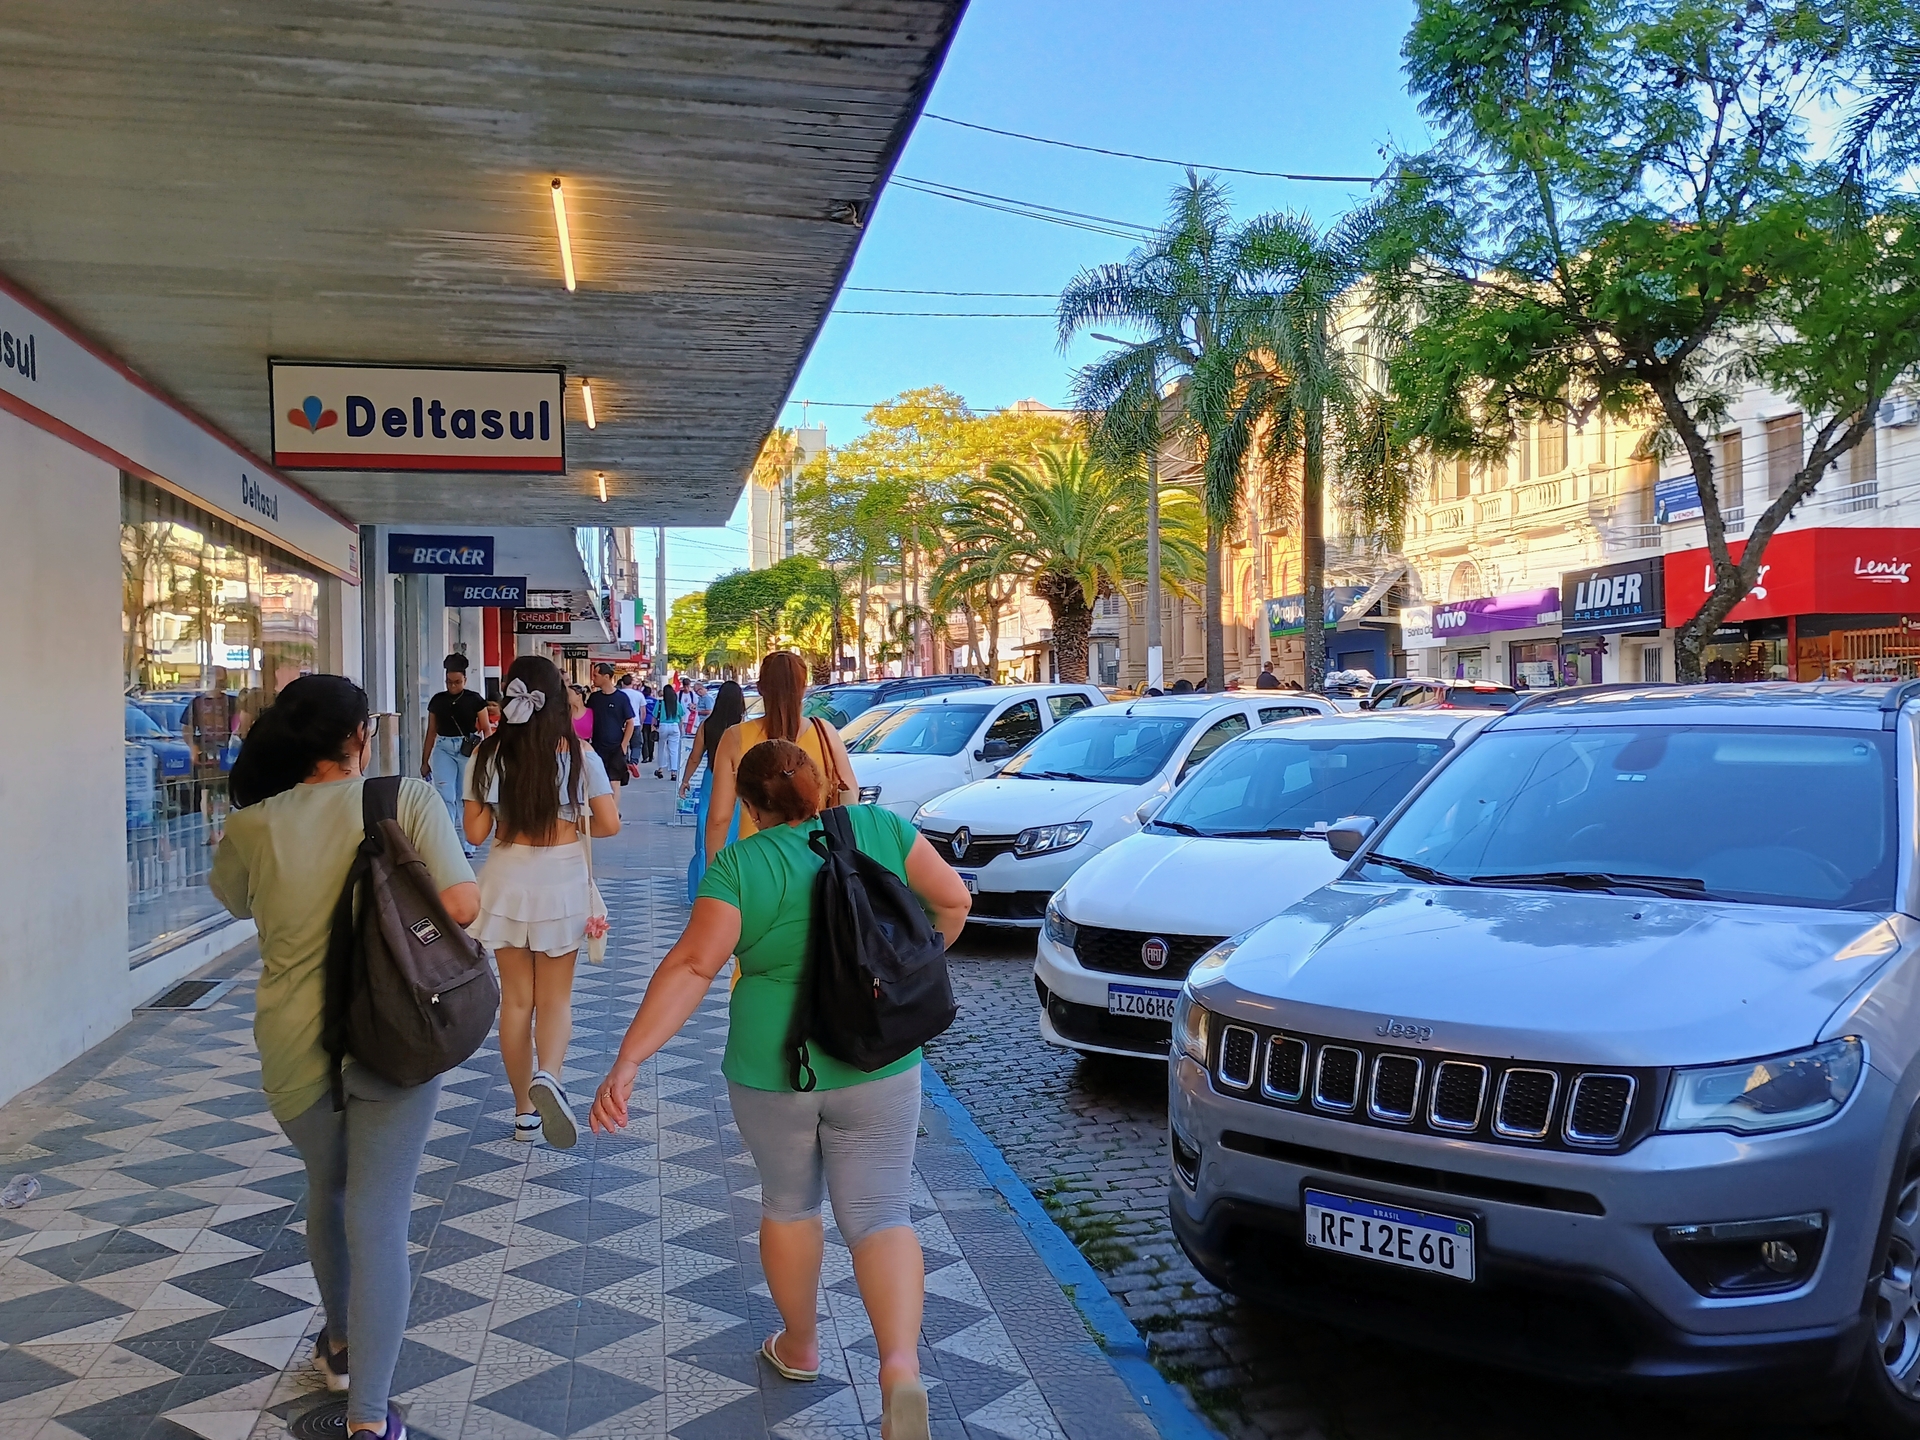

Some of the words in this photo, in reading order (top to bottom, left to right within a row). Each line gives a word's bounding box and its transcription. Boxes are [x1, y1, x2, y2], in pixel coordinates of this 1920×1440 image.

[0, 328, 36, 381] sul
[346, 395, 549, 441] Deltasul
[242, 473, 278, 522] Deltasul
[412, 546, 485, 565] BECKER
[1854, 556, 1912, 575] Lenir
[463, 585, 520, 600] BECKER
[1574, 573, 1642, 611] LÍDER
[521, 613, 551, 622] CHENS
[1436, 606, 1467, 629] vivo
[1574, 605, 1642, 621] PREMIUM
[525, 622, 564, 631] Presentes
[1407, 627, 1423, 637] Santa
[1146, 948, 1162, 961] FIAT
[1116, 994, 1175, 1018] IZO6H6
[1376, 1018, 1434, 1044] Jeep
[1373, 1208, 1400, 1221] BRASIL
[1320, 1211, 1455, 1270] RFI2E60
